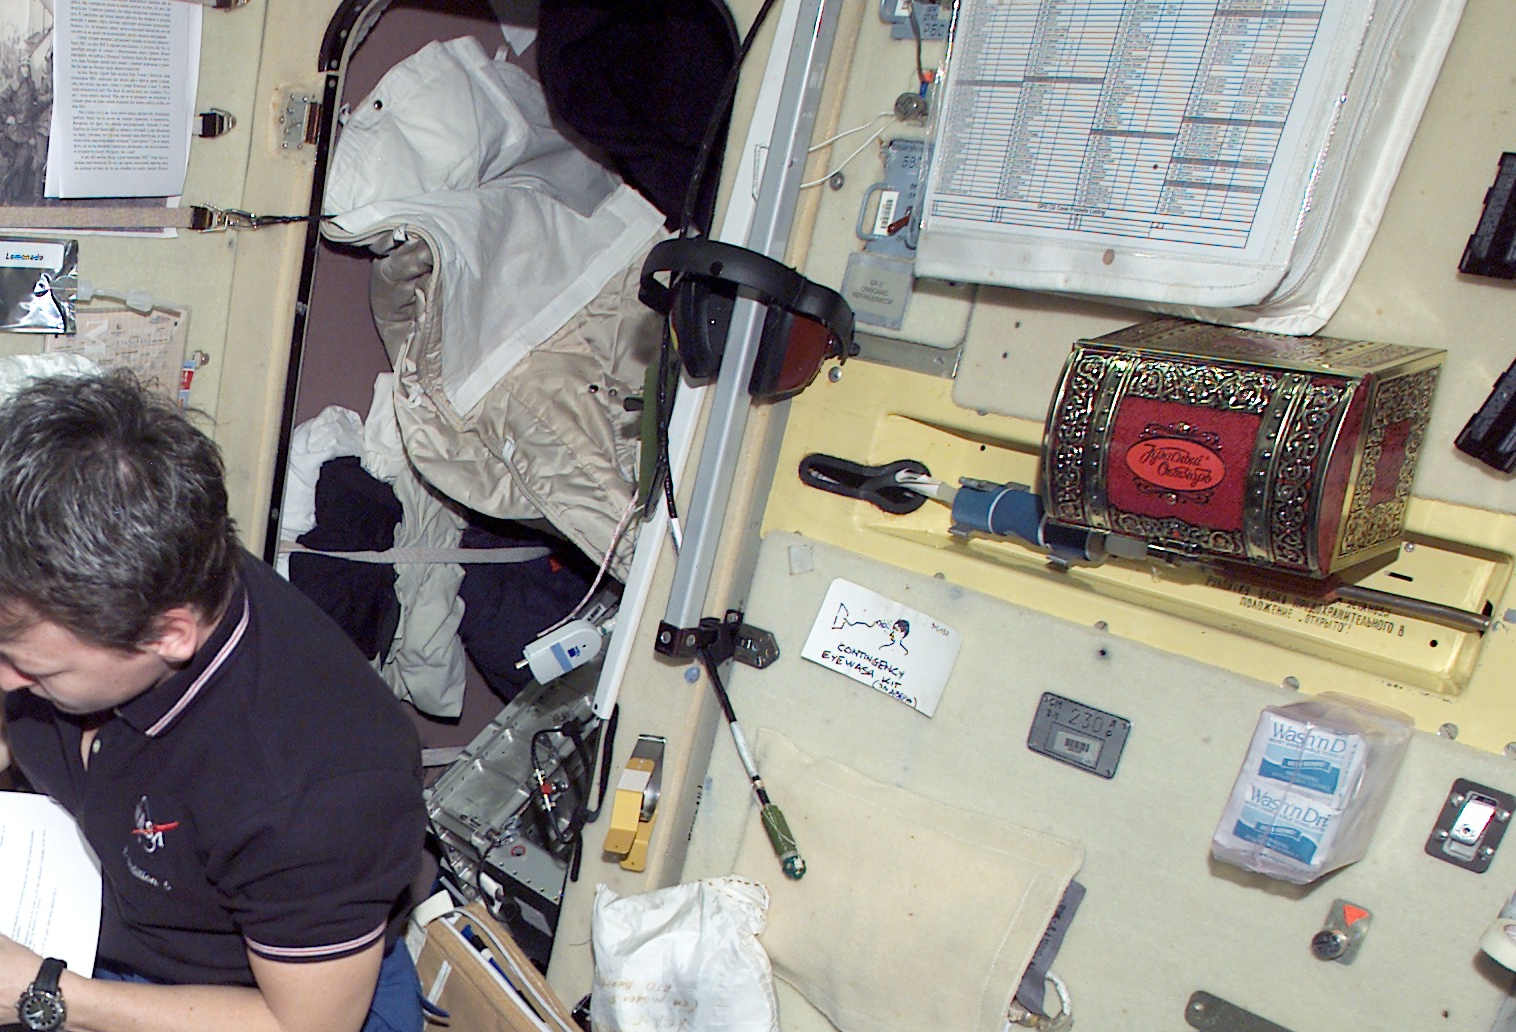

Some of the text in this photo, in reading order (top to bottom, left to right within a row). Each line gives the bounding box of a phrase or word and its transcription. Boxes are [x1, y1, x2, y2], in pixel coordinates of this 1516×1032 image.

[5, 252, 44, 261] Lemonade
[1239, 596, 1293, 620] ПОЛОЖЕНИЕ
[837, 643, 905, 679] CONTINGENCY
[1069, 707, 1103, 733] 230
